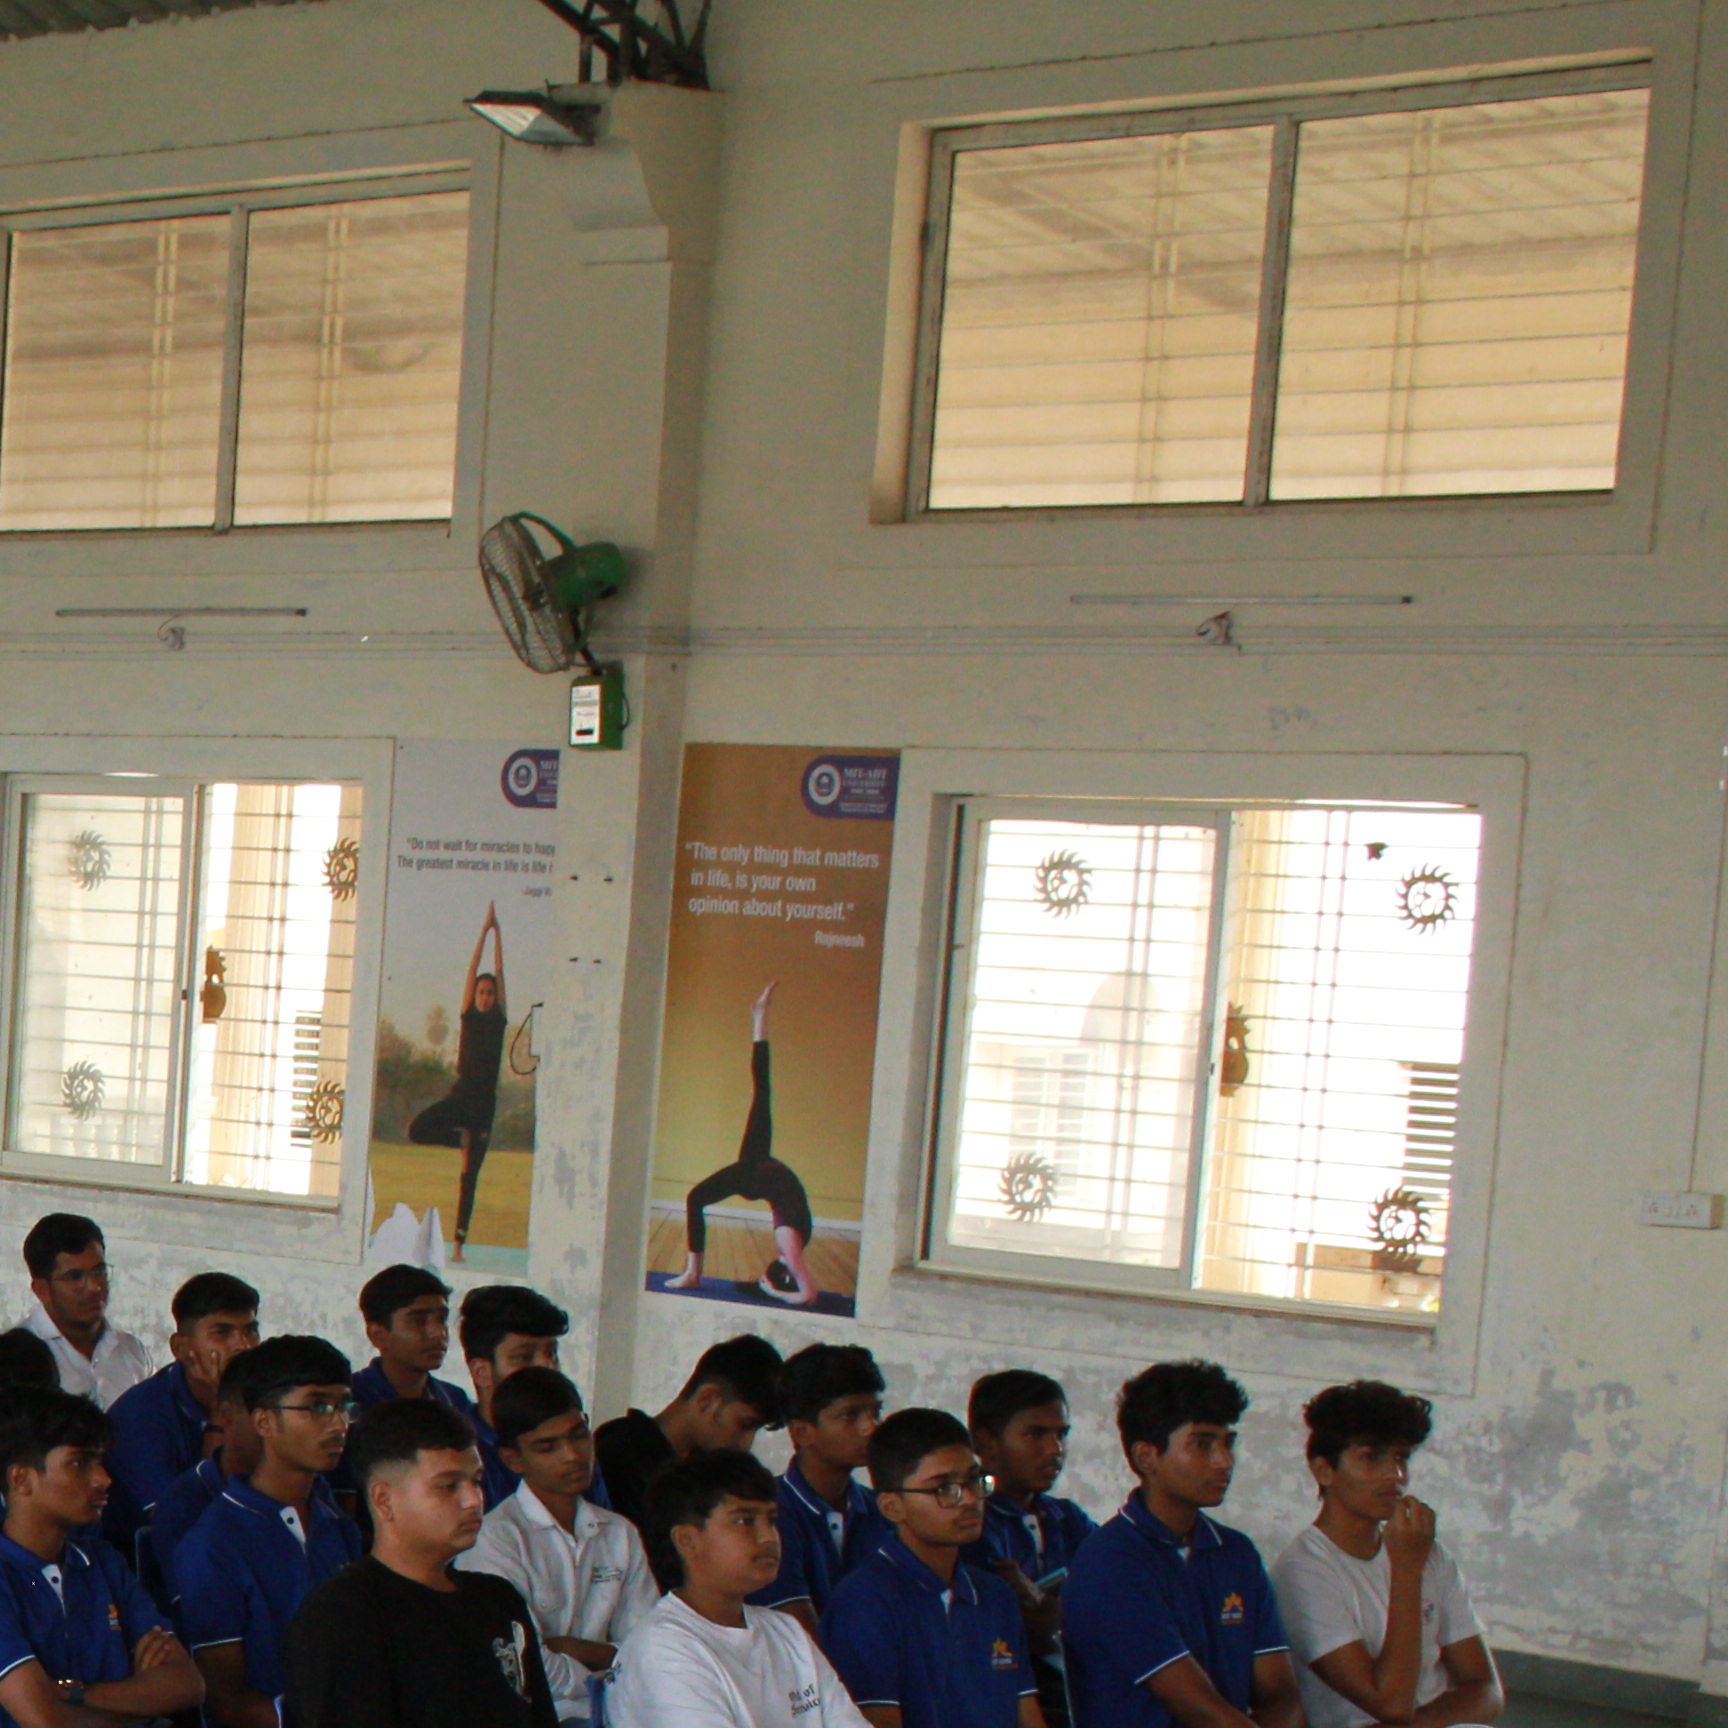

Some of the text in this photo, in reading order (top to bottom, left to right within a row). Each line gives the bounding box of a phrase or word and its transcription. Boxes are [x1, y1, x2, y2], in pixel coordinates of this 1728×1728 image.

[397, 855, 413, 868] The
[720, 844, 750, 866] only
[754, 845, 789, 868] thing
[793, 847, 821, 866] that
[825, 849, 879, 868] matters
[691, 869, 816, 893] in life, is your own
[688, 896, 739, 916] opinion
[743, 898, 782, 916] about
